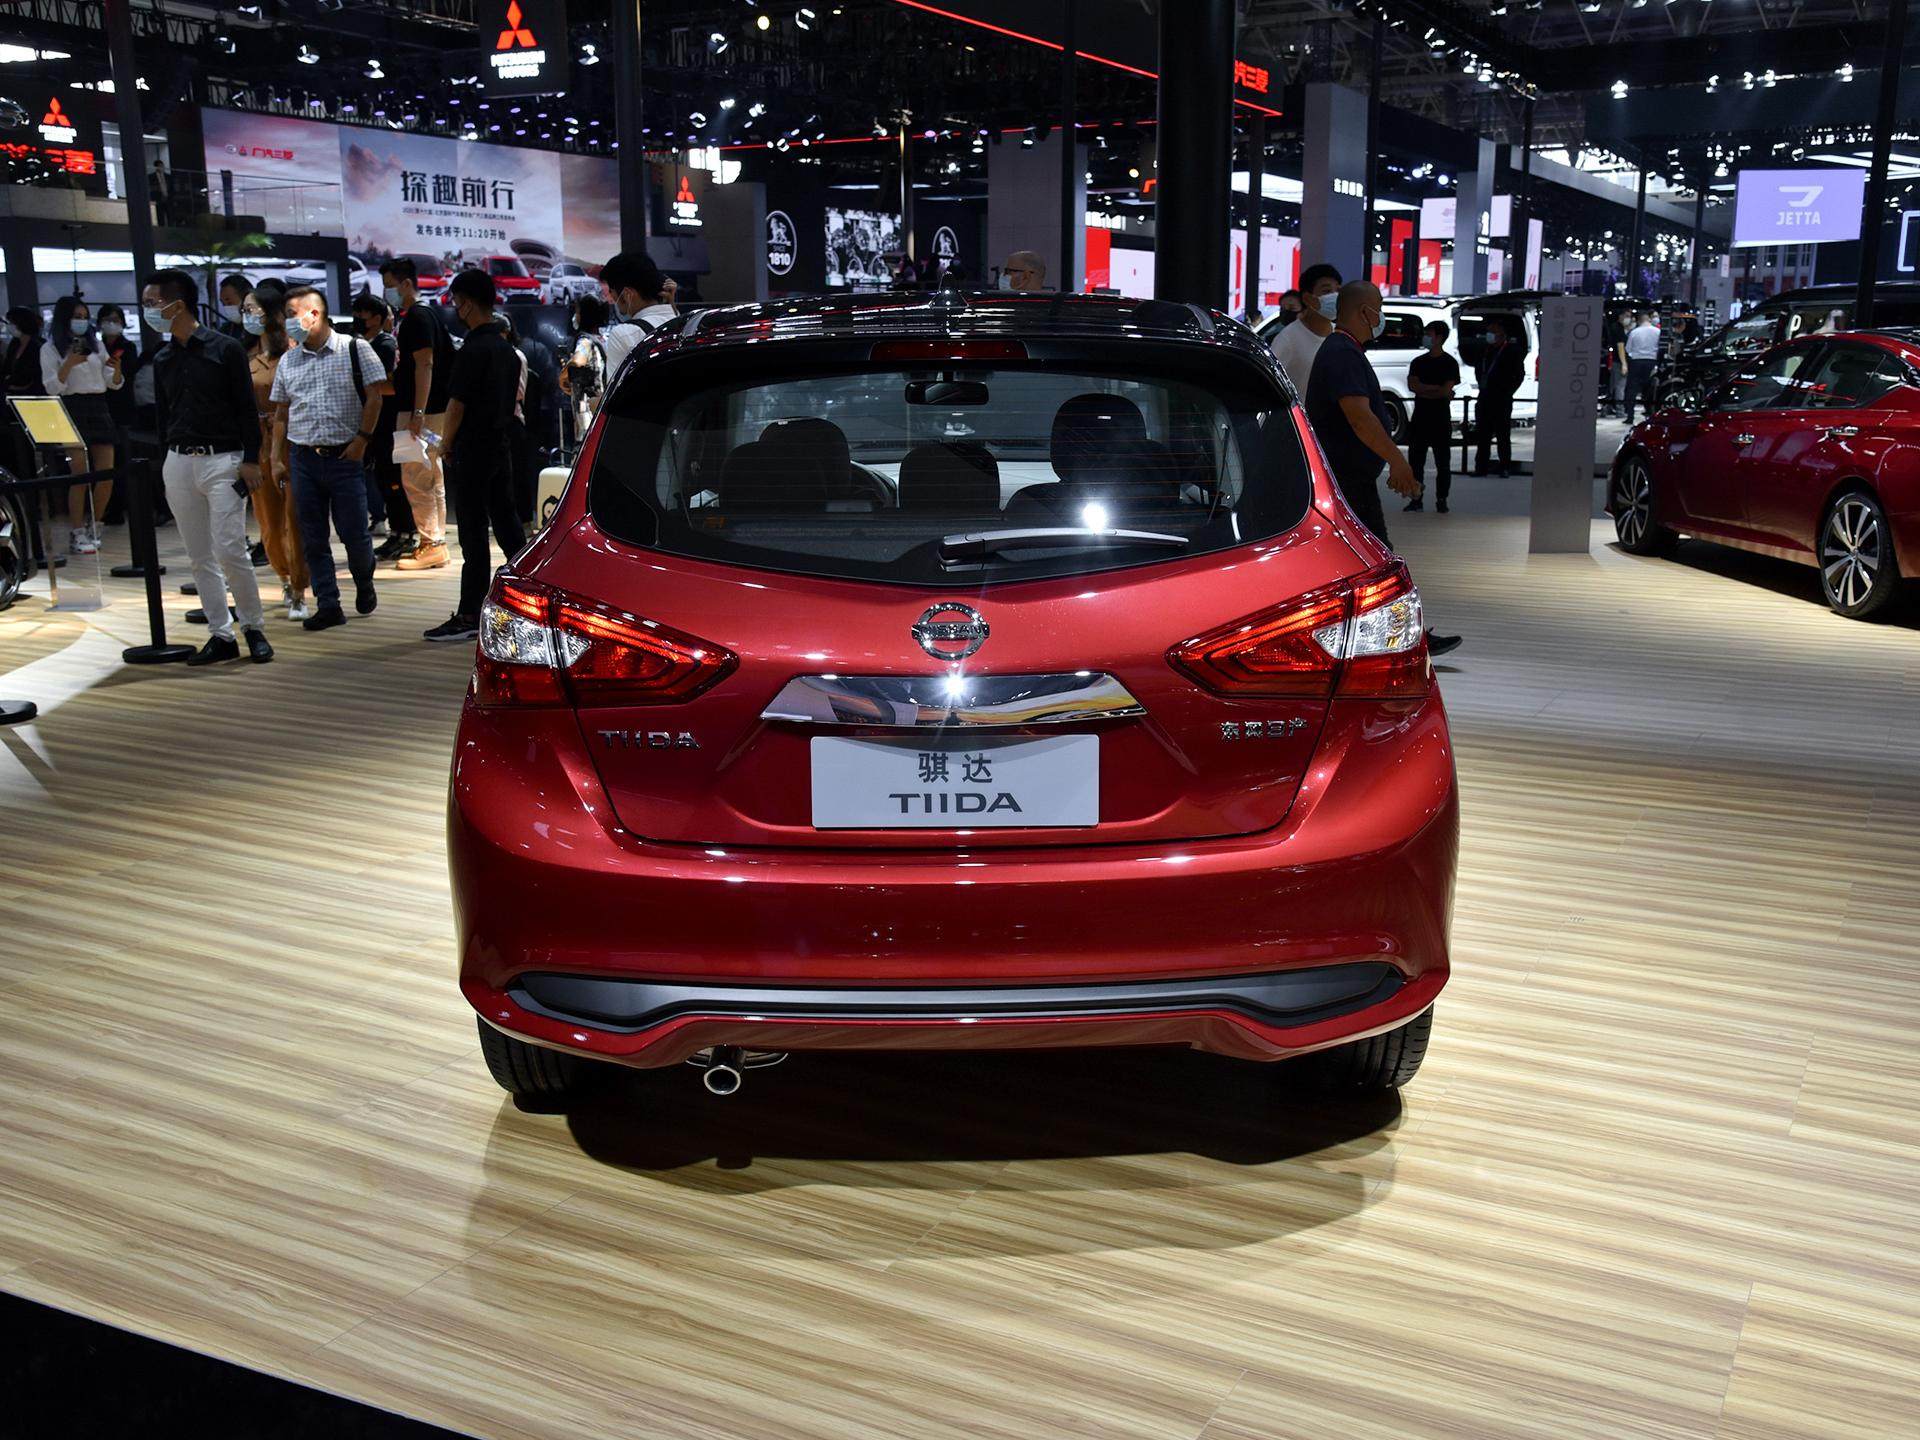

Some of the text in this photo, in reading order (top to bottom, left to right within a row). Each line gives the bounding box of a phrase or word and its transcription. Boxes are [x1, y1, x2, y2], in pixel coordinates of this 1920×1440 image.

[400, 170, 514, 210] 探趣前行
[1776, 211, 1821, 225] JETTA
[768, 252, 791, 266] 1810
[597, 729, 701, 750] TIIDA
[888, 792, 1023, 813] TIIDA
